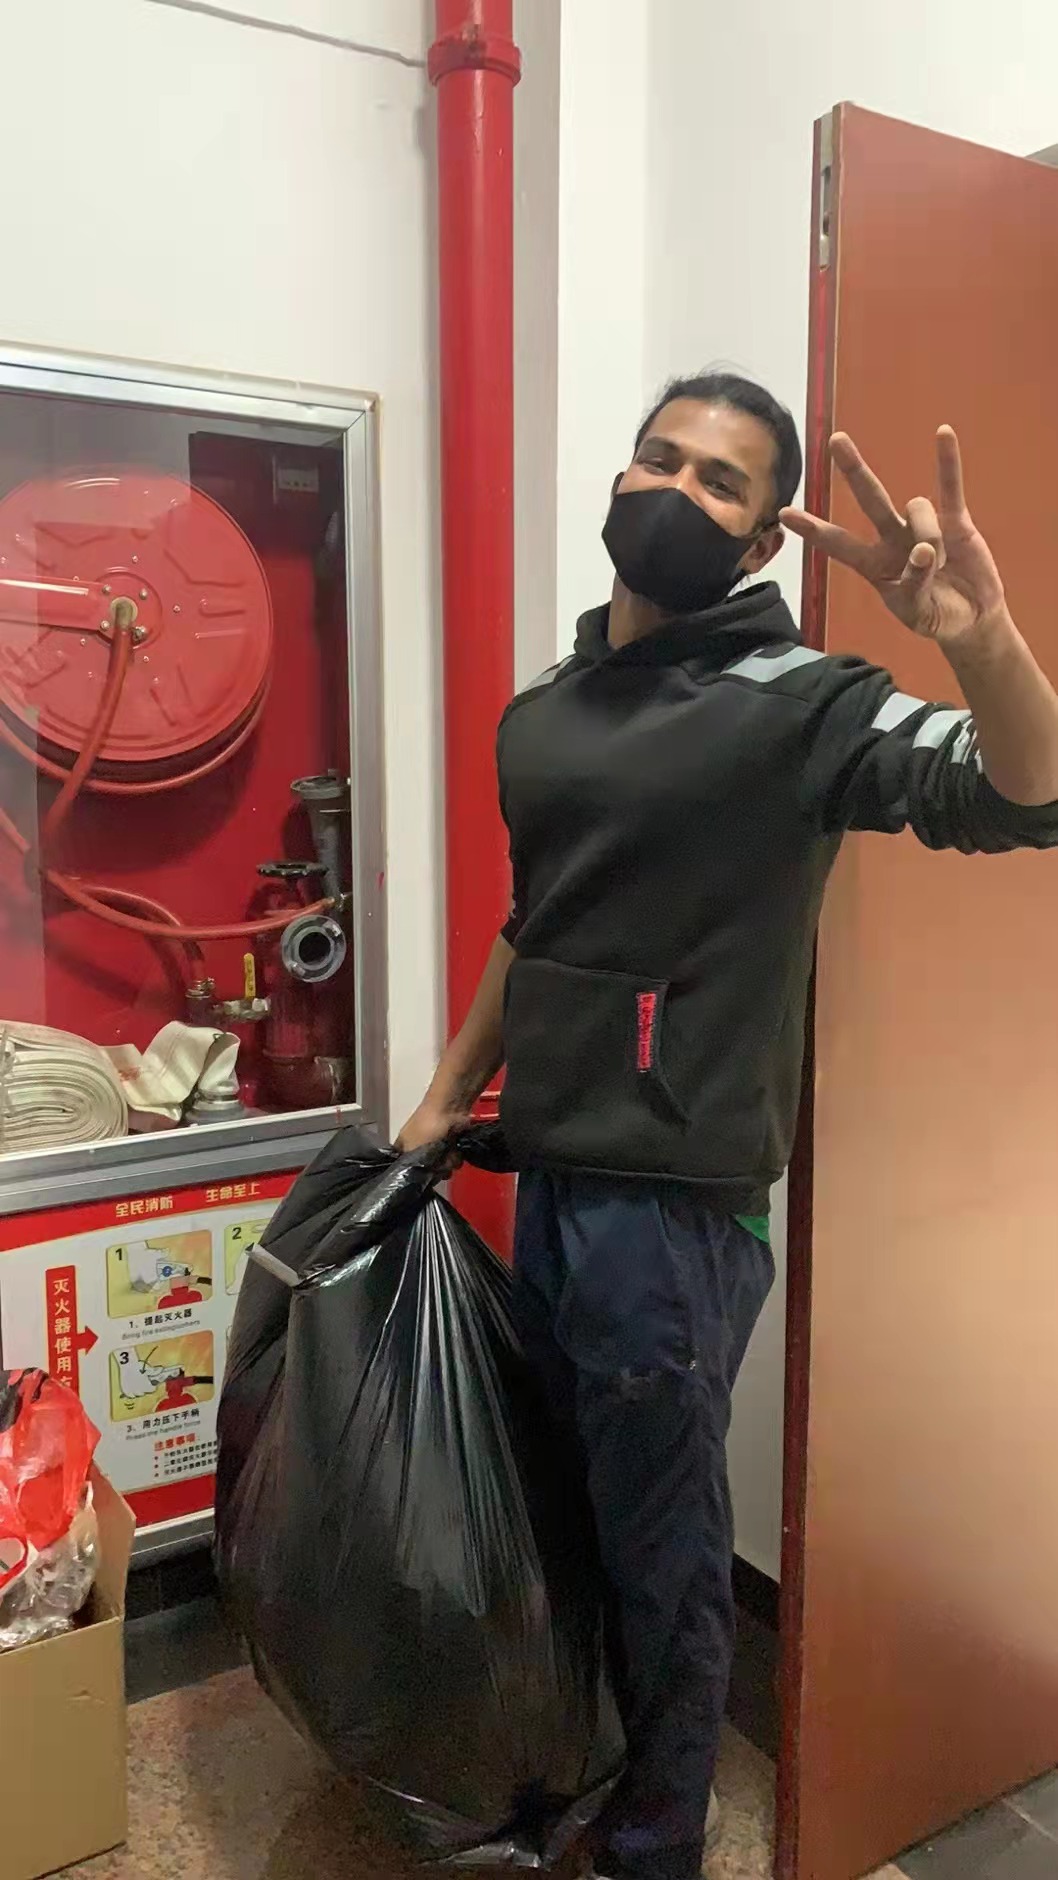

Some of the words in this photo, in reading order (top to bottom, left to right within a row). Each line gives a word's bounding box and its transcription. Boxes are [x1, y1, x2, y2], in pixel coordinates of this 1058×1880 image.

[206, 1182, 261, 1203] 生命至上
[115, 1195, 173, 1218] 全民消防
[232, 1226, 242, 1240] 2
[115, 1248, 124, 1261] 1
[119, 1351, 129, 1365] 3
